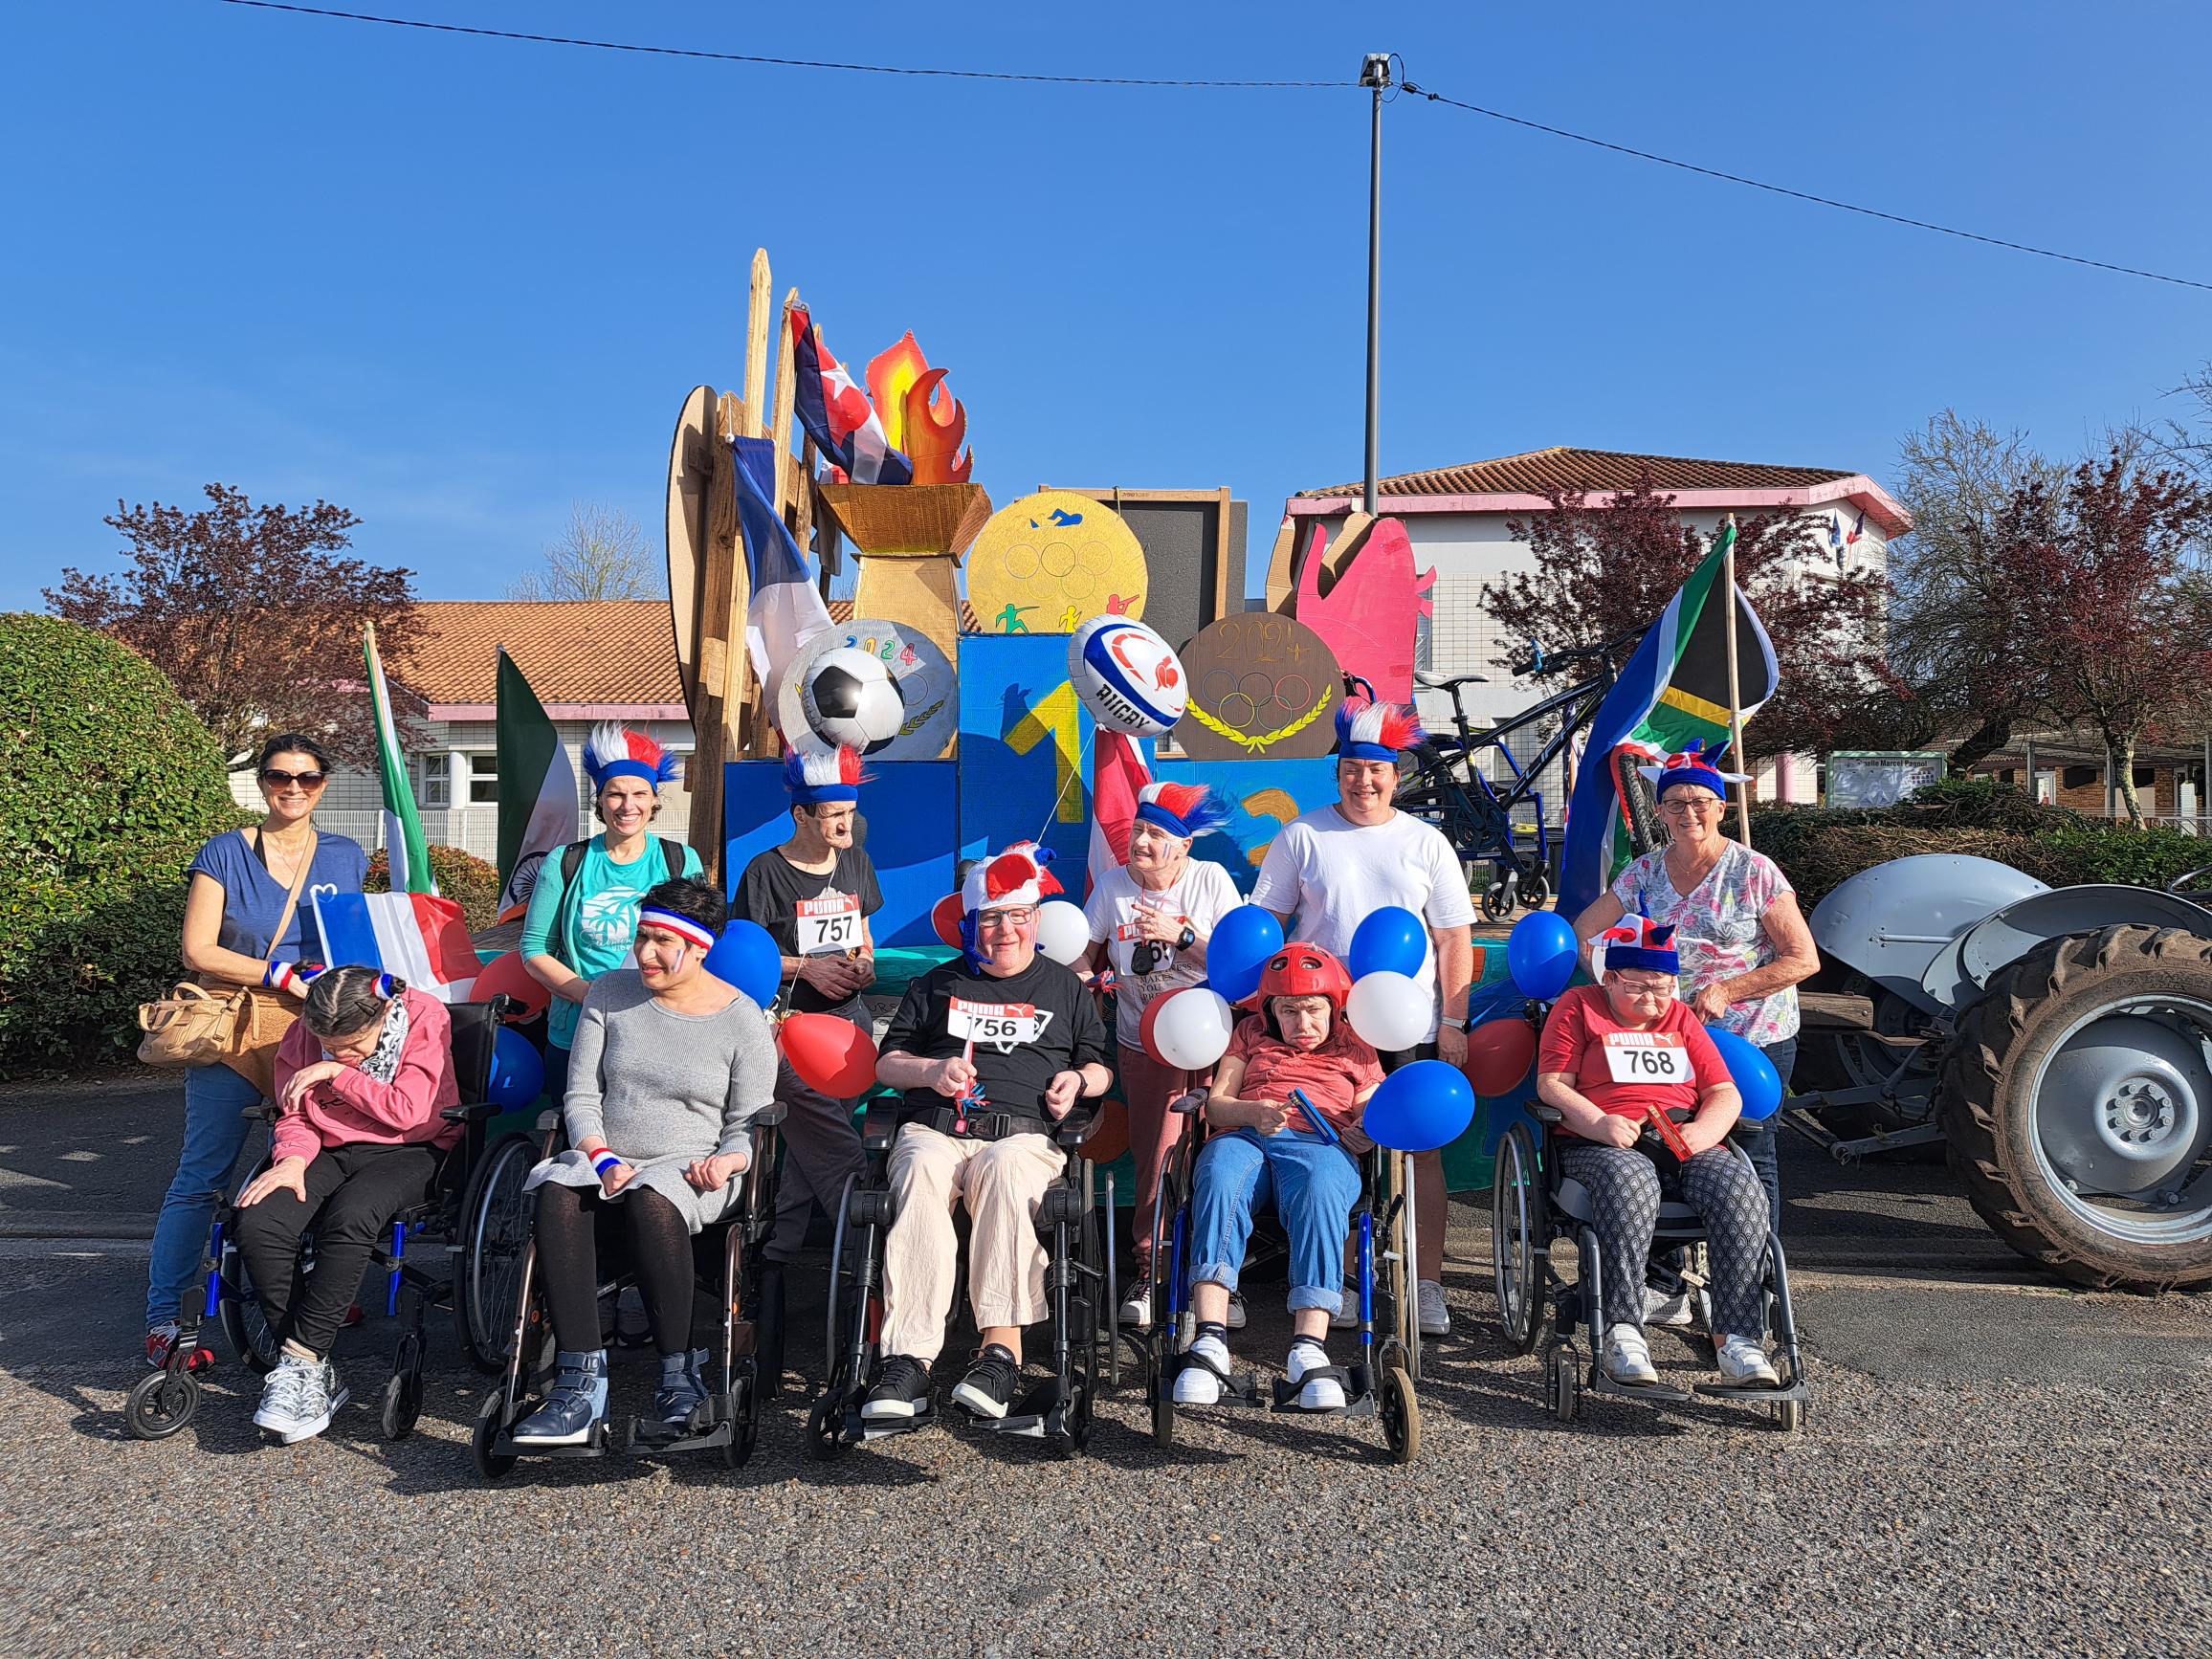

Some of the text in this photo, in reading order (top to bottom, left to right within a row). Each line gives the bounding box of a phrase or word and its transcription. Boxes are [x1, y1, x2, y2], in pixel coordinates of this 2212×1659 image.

[1095, 683, 1150, 729] RUGBY
[804, 897, 845, 916] PUMA
[815, 916, 853, 943] 757
[957, 1000, 1006, 1017] PUMA
[1608, 1032, 1655, 1047] PUMA
[1623, 1050, 1676, 1075] 768
